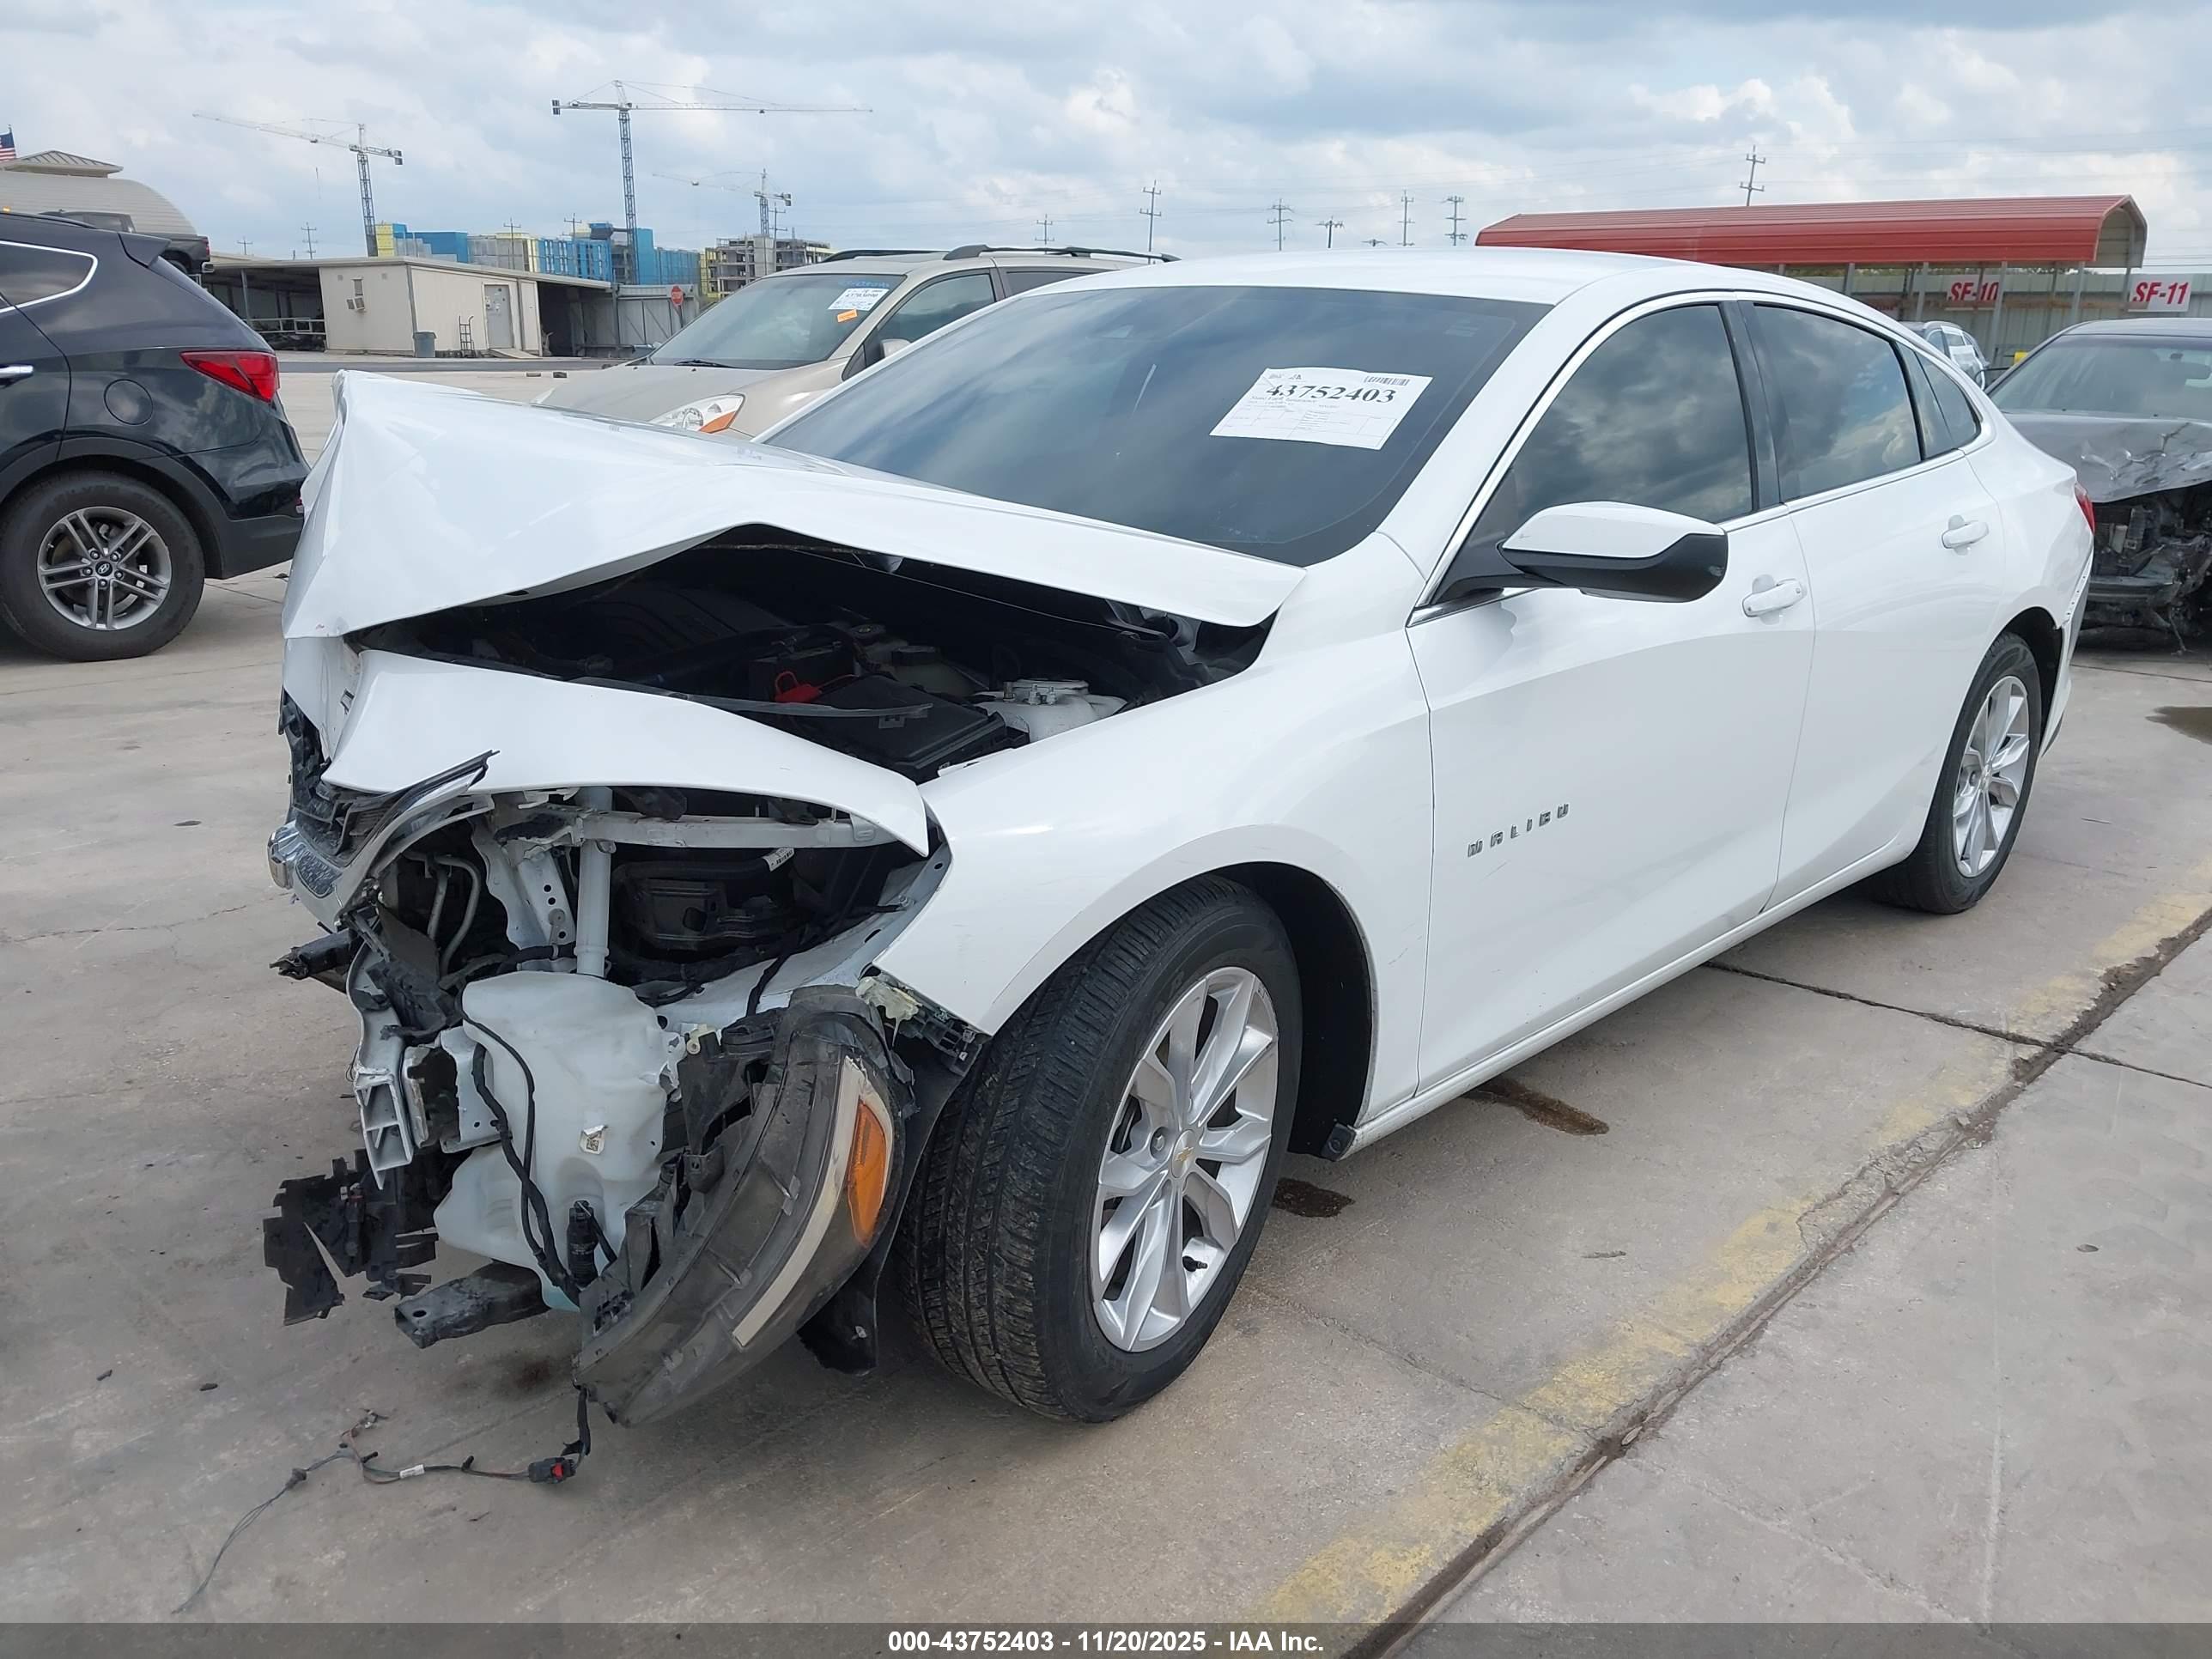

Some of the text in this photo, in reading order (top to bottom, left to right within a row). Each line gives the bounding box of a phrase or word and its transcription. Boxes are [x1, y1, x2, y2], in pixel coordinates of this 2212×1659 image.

[1948, 282, 1999, 301] SF-10
[2132, 282, 2189, 305] SF-11
[1266, 384, 1397, 404] 43752403
[1468, 803, 1570, 857] MALIBU
